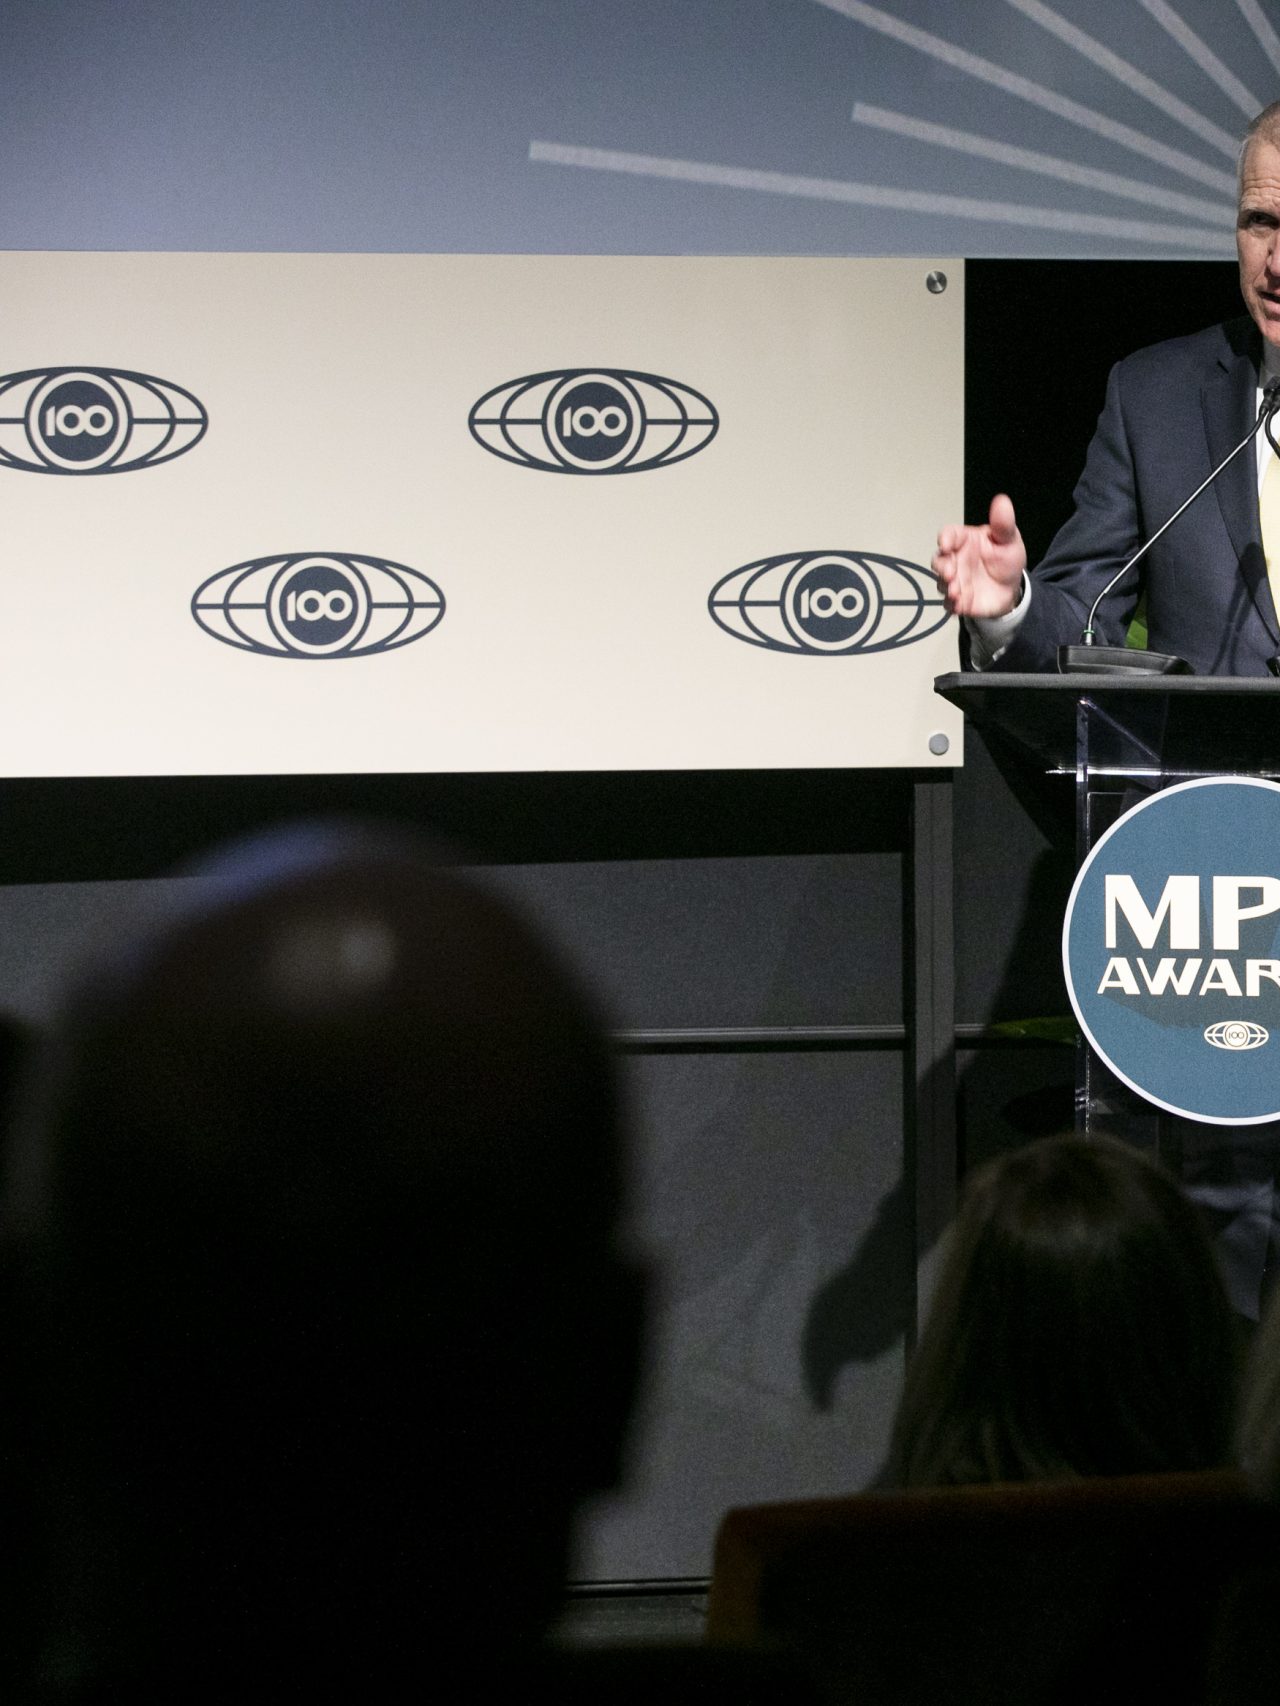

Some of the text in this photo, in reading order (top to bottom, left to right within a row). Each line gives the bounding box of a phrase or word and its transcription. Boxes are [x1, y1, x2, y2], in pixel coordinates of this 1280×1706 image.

[46, 404, 113, 437] 100
[562, 405, 628, 437] 100
[287, 589, 353, 622] 100
[800, 587, 865, 619] 100
